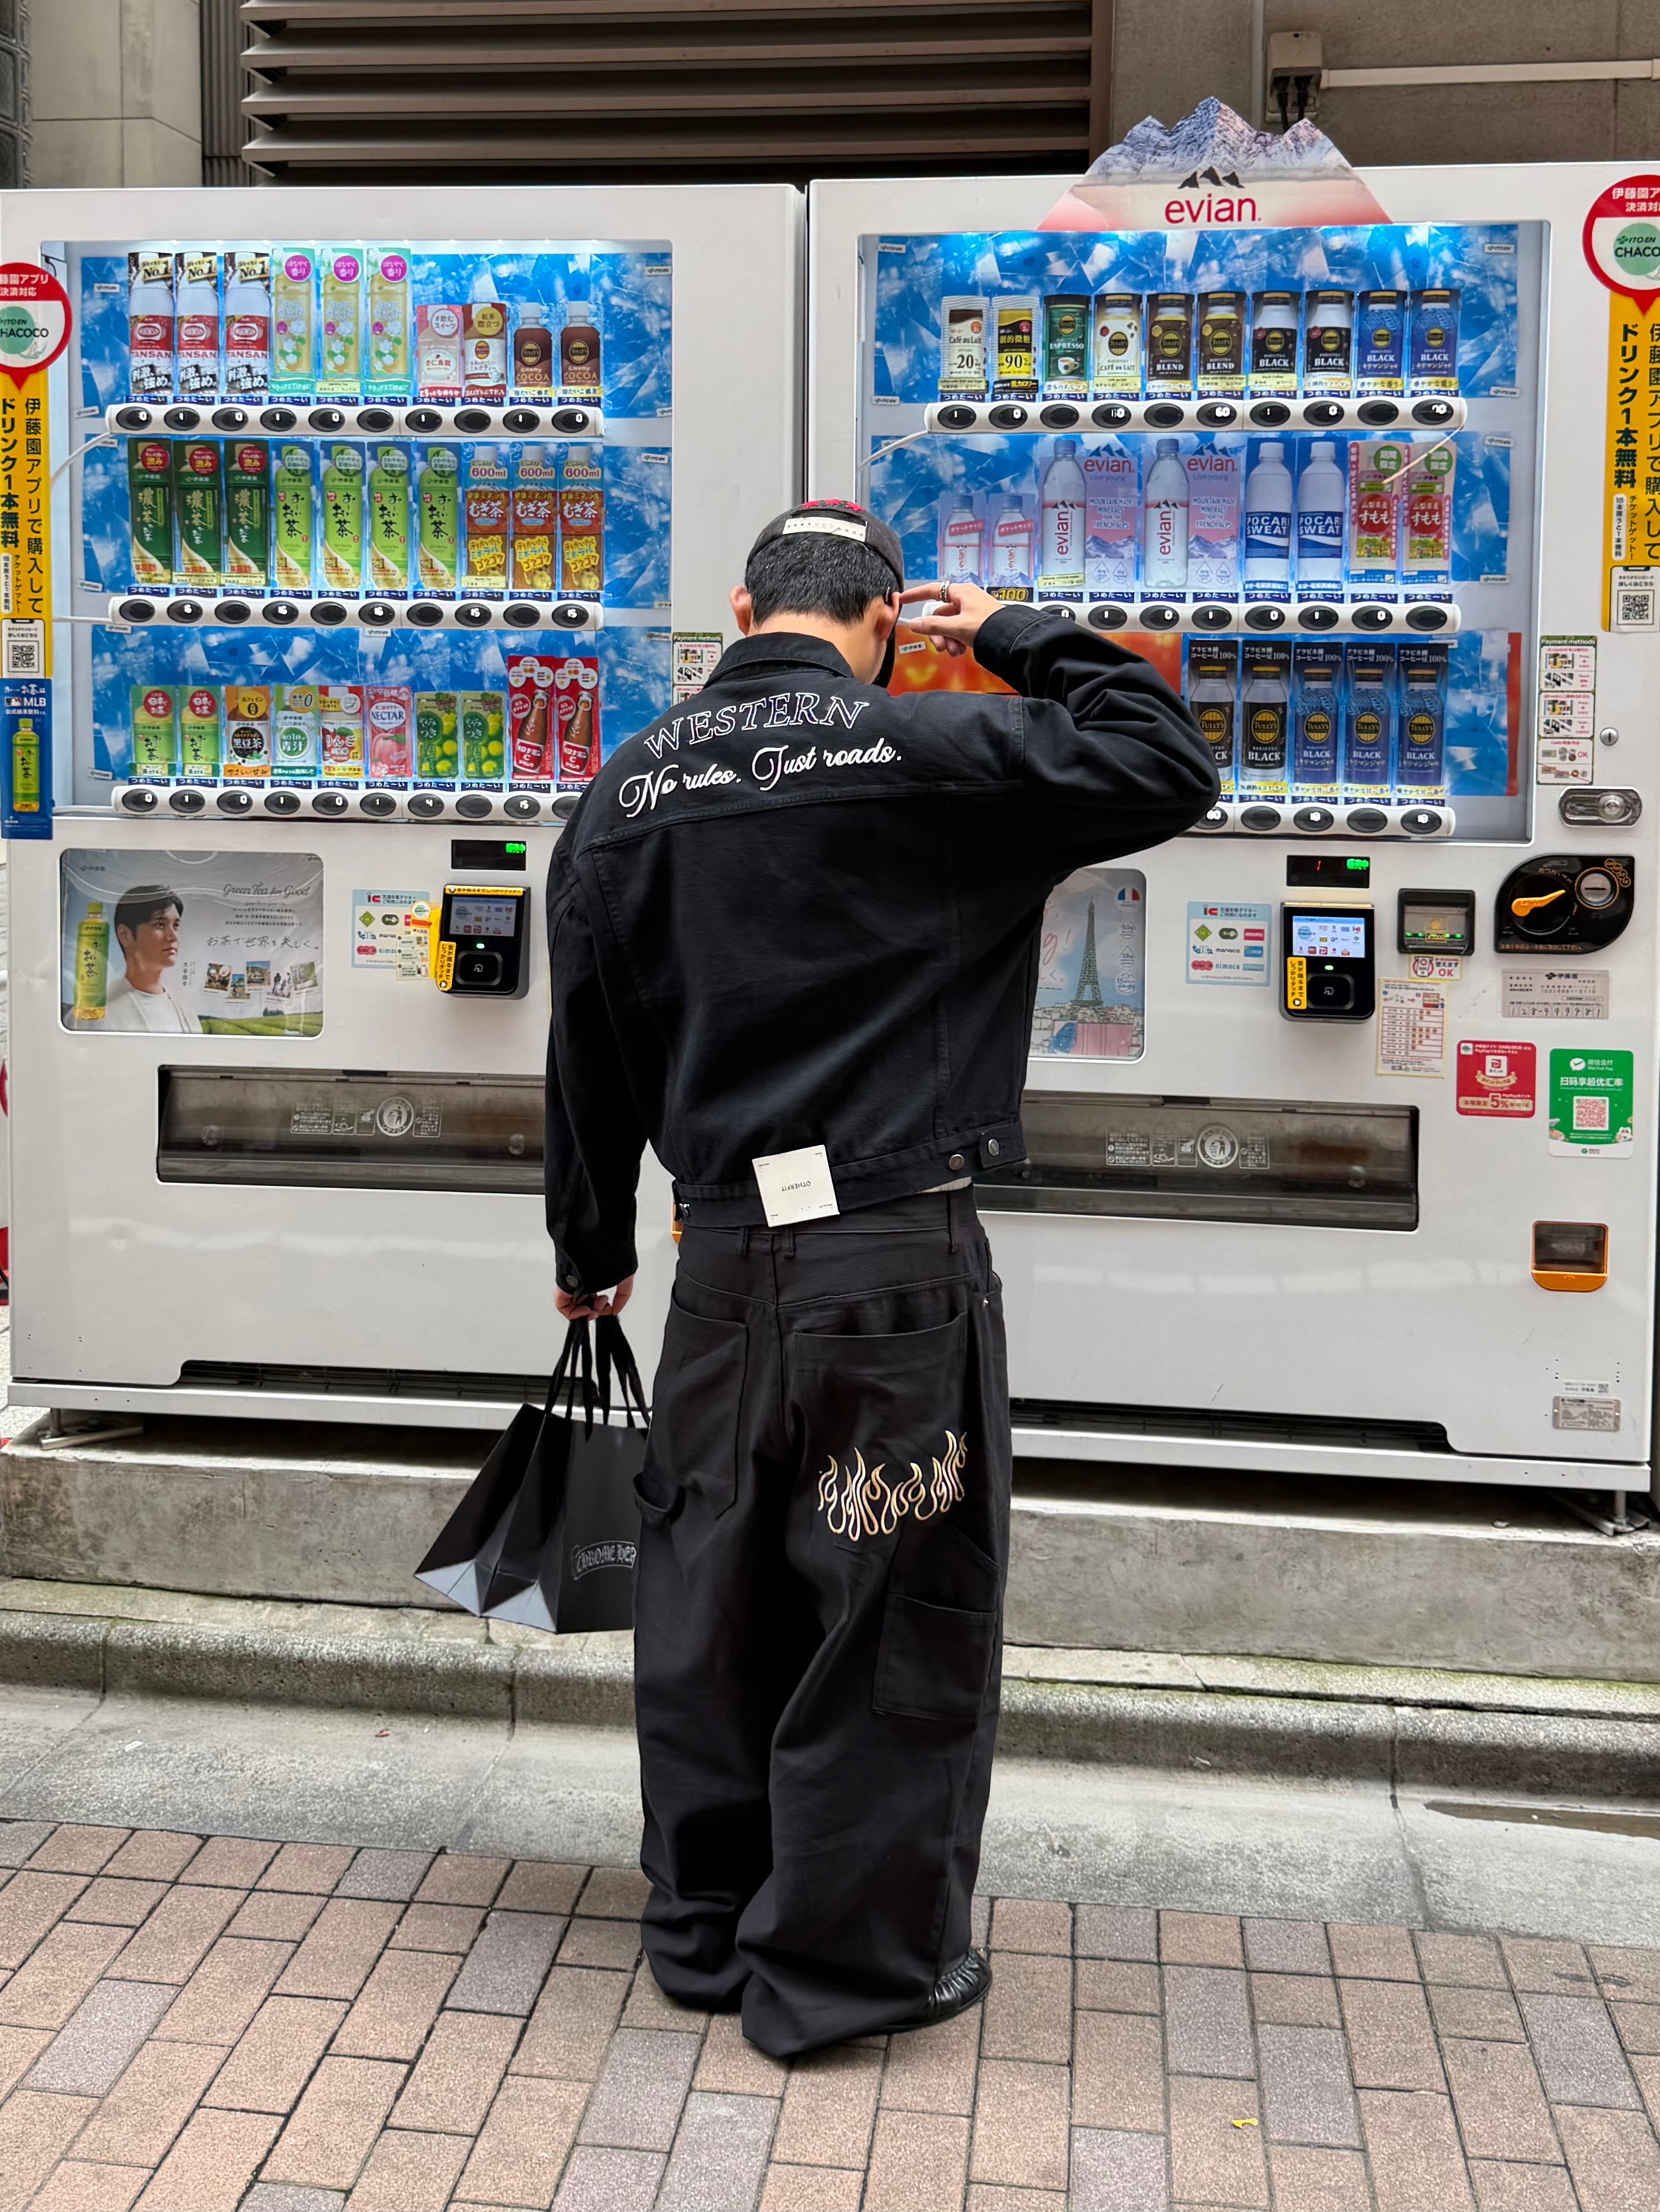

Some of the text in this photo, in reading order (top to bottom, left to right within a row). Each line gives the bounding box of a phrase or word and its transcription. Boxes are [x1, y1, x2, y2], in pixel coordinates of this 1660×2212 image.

[1165, 194, 1256, 224] evian
[1626, 202, 1660, 212] 決済対
[1614, 324, 1638, 488] ドリンク1本無料
[1084, 457, 1132, 473] evian
[1187, 456, 1235, 472] evian
[1, 398, 19, 548] ドリンク1本無料
[472, 467, 506, 477] 600ml
[521, 467, 553, 477] 600ml
[566, 467, 599, 477] 600ml
[25, 397, 44, 613] 伊藤園アプリで購入して
[469, 501, 504, 519] むぎ茶
[516, 501, 551, 519] むぎ茶
[563, 501, 597, 519] むぎ茶
[1246, 517, 1289, 526] POCARI
[1360, 511, 1389, 525] すもも
[1411, 511, 1441, 525] すもも
[1054, 510, 1069, 555] evian
[1157, 511, 1171, 555] evian
[1246, 526, 1286, 535] SWEAT
[1299, 526, 1339, 535] SWEAT
[478, 554, 504, 570] ゴクゴク
[524, 554, 550, 570] ゴクゴク
[572, 554, 598, 570] ゴクゴク
[23, 698, 46, 707] MLB
[371, 711, 404, 720] NECTAR
[645, 692, 869, 759] WESTERN
[233, 738, 262, 749] 黒豆茶
[282, 741, 304, 751] 青汁
[326, 736, 356, 746] りんご
[1248, 752, 1280, 761] BLACK
[620, 738, 903, 818] No rules. Just roads.
[223, 884, 251, 897] Green
[252, 882, 268, 895] Tea
[284, 885, 310, 899] Good
[1439, 968, 1453, 977] OK
[1491, 1095, 1509, 1108] 5%
